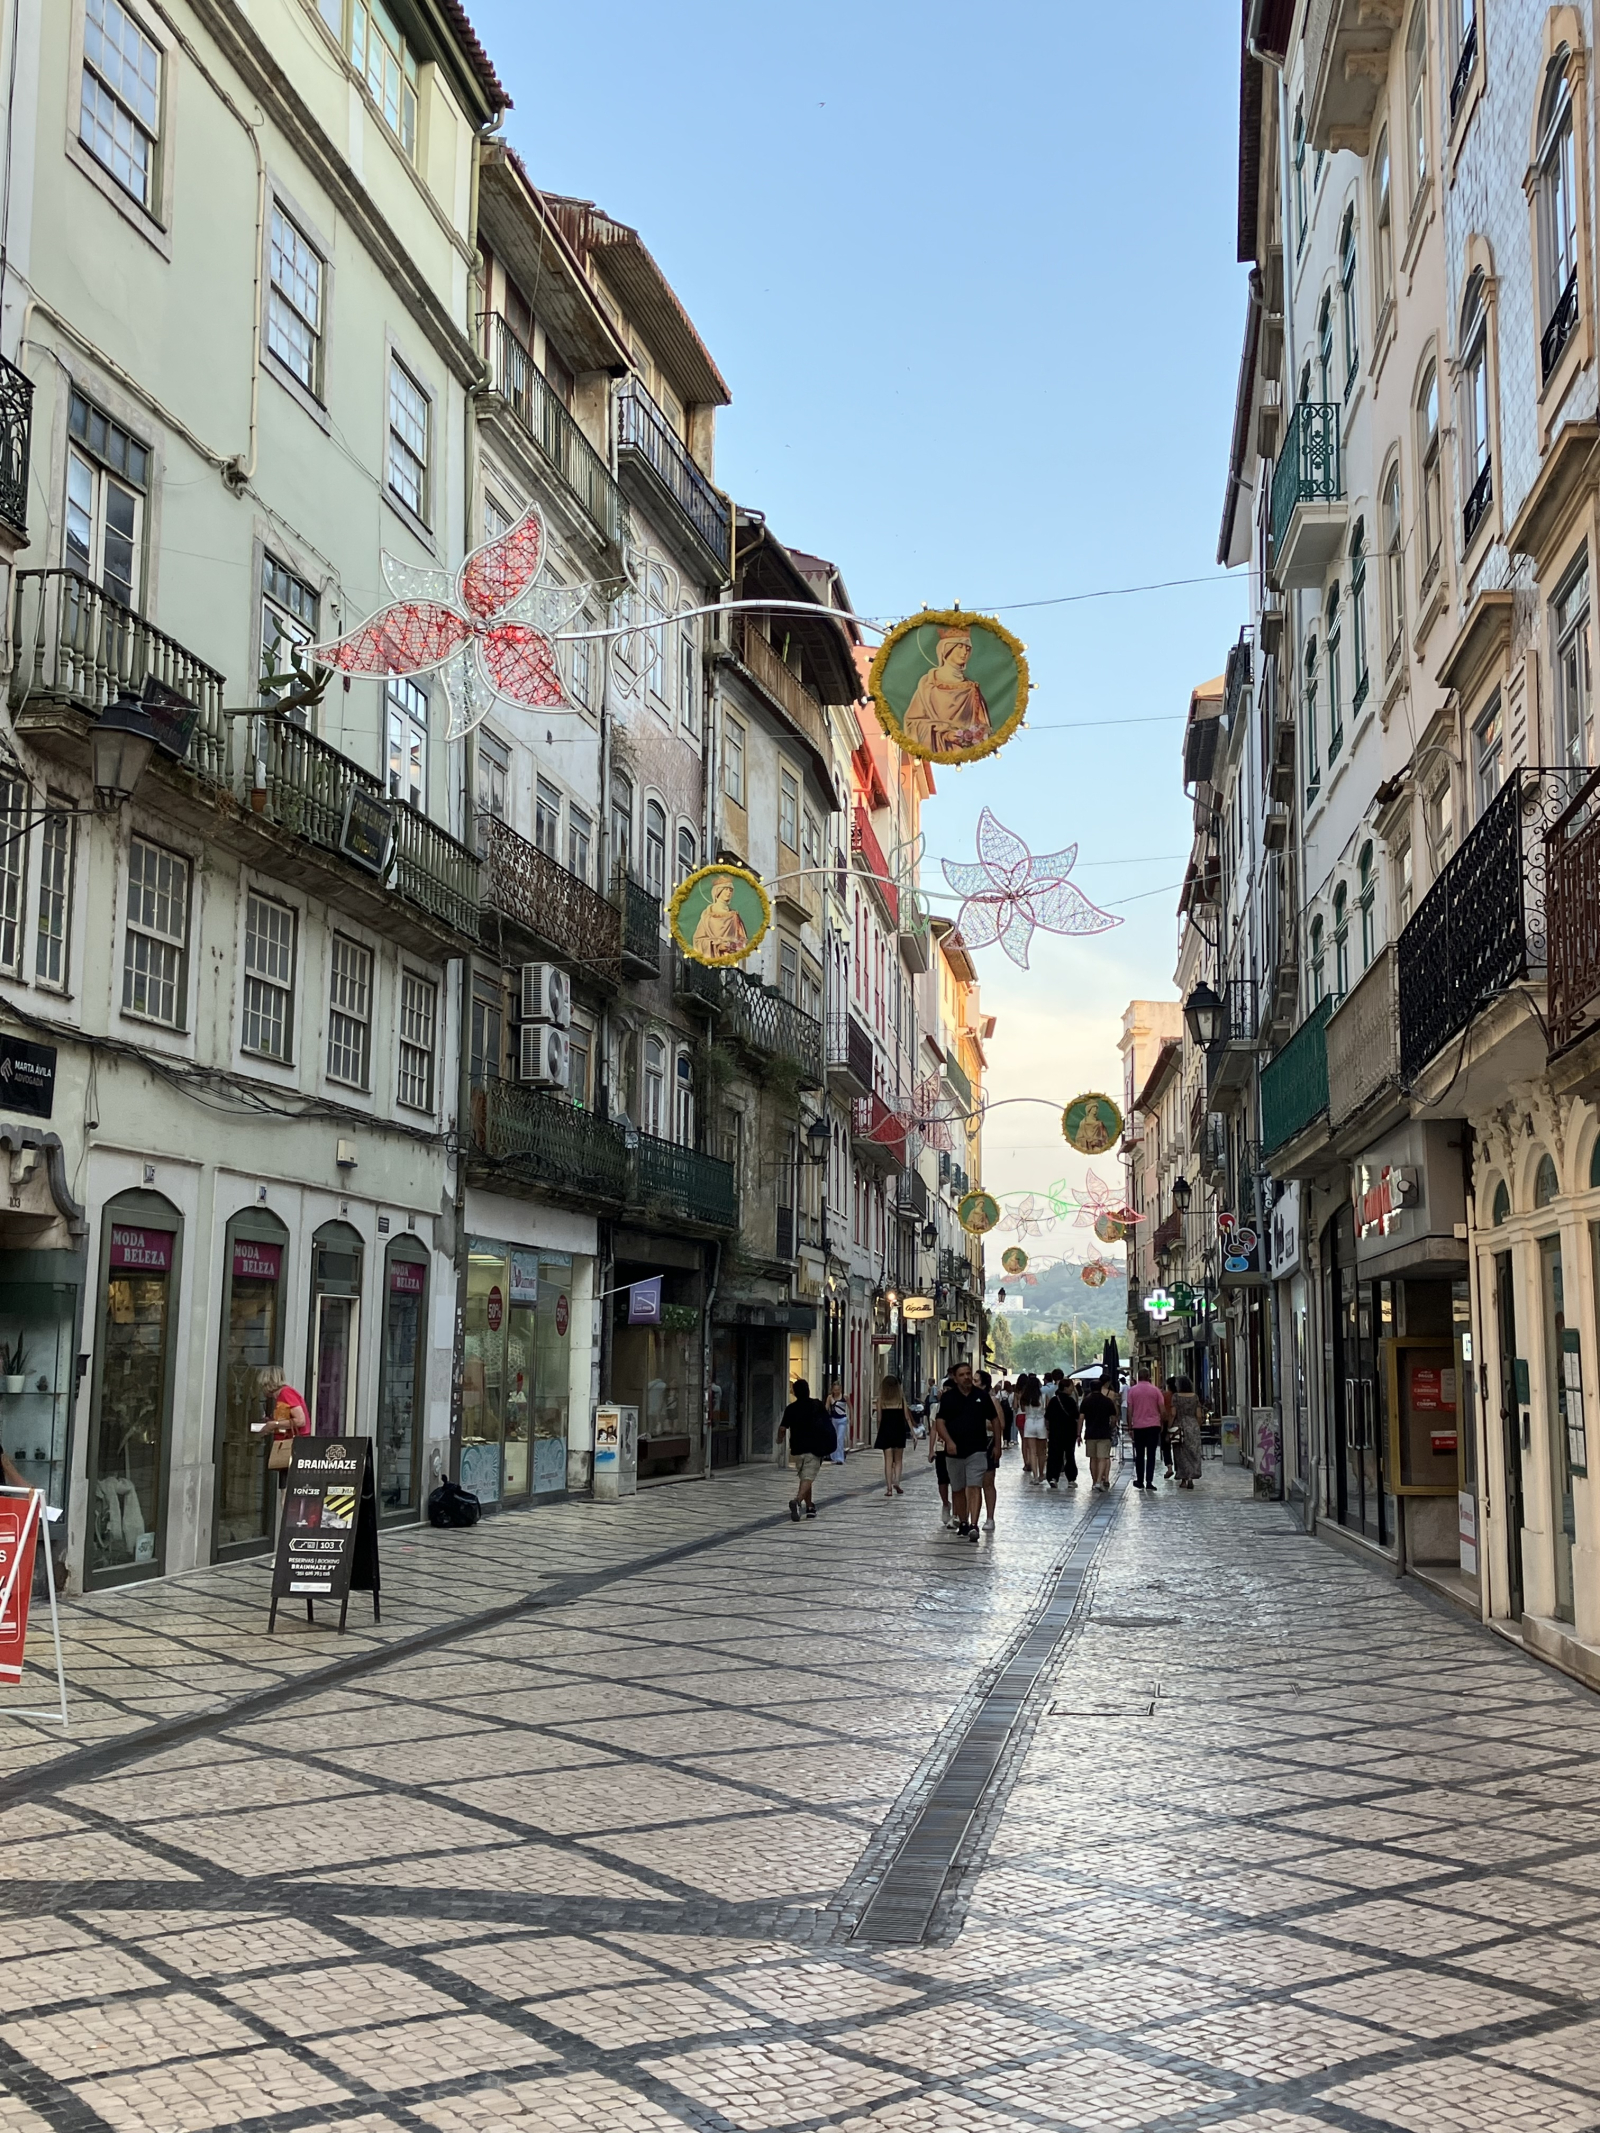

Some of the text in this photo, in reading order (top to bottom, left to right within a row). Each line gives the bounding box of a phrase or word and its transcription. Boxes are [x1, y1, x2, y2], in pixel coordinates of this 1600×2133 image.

[15, 1060, 52, 1078] MARTA ÁVILA
[14, 1073, 43, 1087] ADVOGADA
[113, 1231, 145, 1248] MODA
[124, 1247, 165, 1266] BELEZA
[234, 1244, 259, 1260] MODA
[242, 1259, 275, 1276] BELEZA
[391, 1263, 409, 1277] MODA
[396, 1276, 420, 1290] BELEZA
[488, 1303, 502, 1319] 50%
[297, 1459, 357, 1470] BRAINMAZE
[320, 1541, 335, 1550] 103
